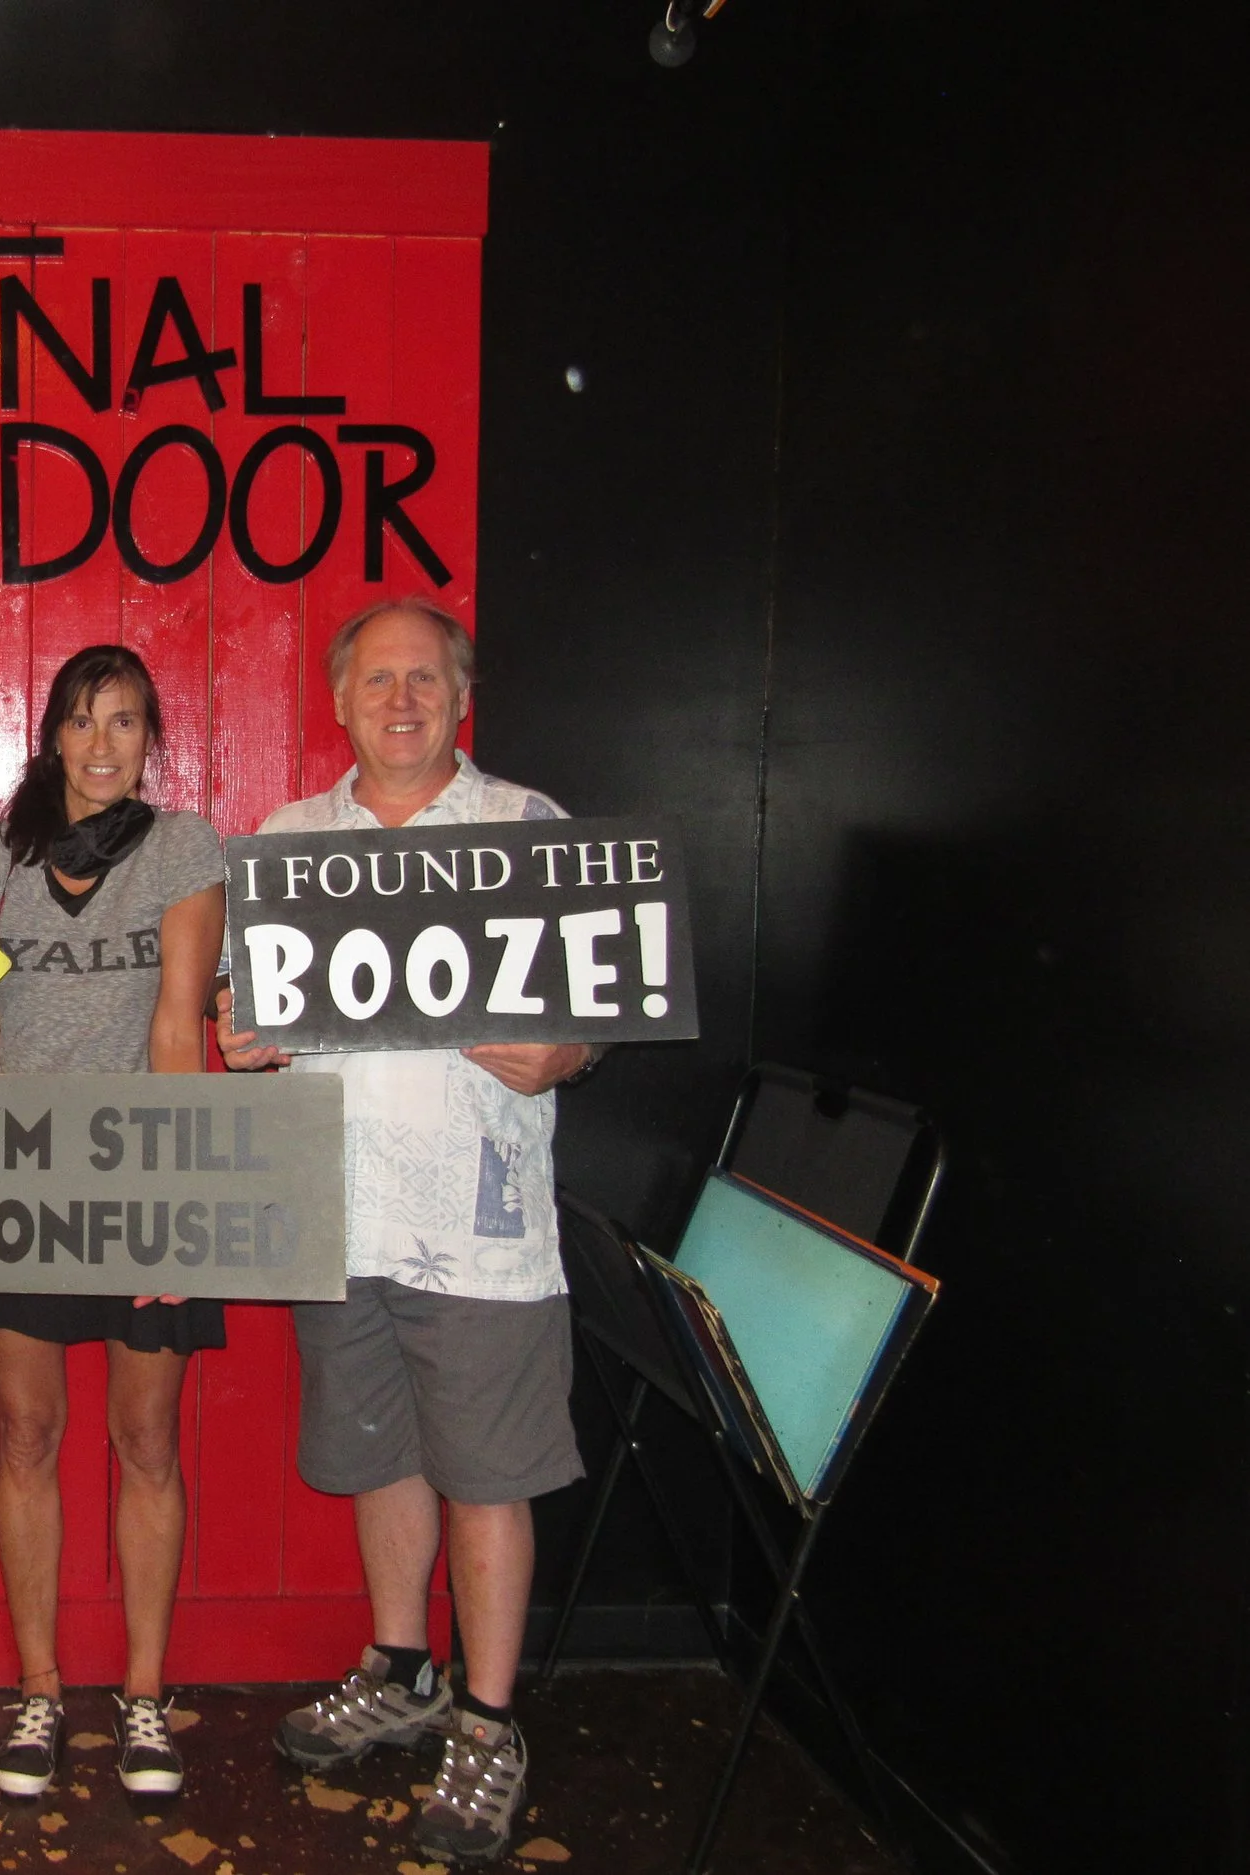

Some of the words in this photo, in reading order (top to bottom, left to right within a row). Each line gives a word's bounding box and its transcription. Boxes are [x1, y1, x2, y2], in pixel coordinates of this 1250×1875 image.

[0, 422, 454, 588] DOOR
[242, 858, 262, 901] I
[281, 847, 512, 900] FOUND
[531, 840, 664, 888] THE
[244, 902, 667, 1027] BOOZE!
[89, 1106, 271, 1172] STILL
